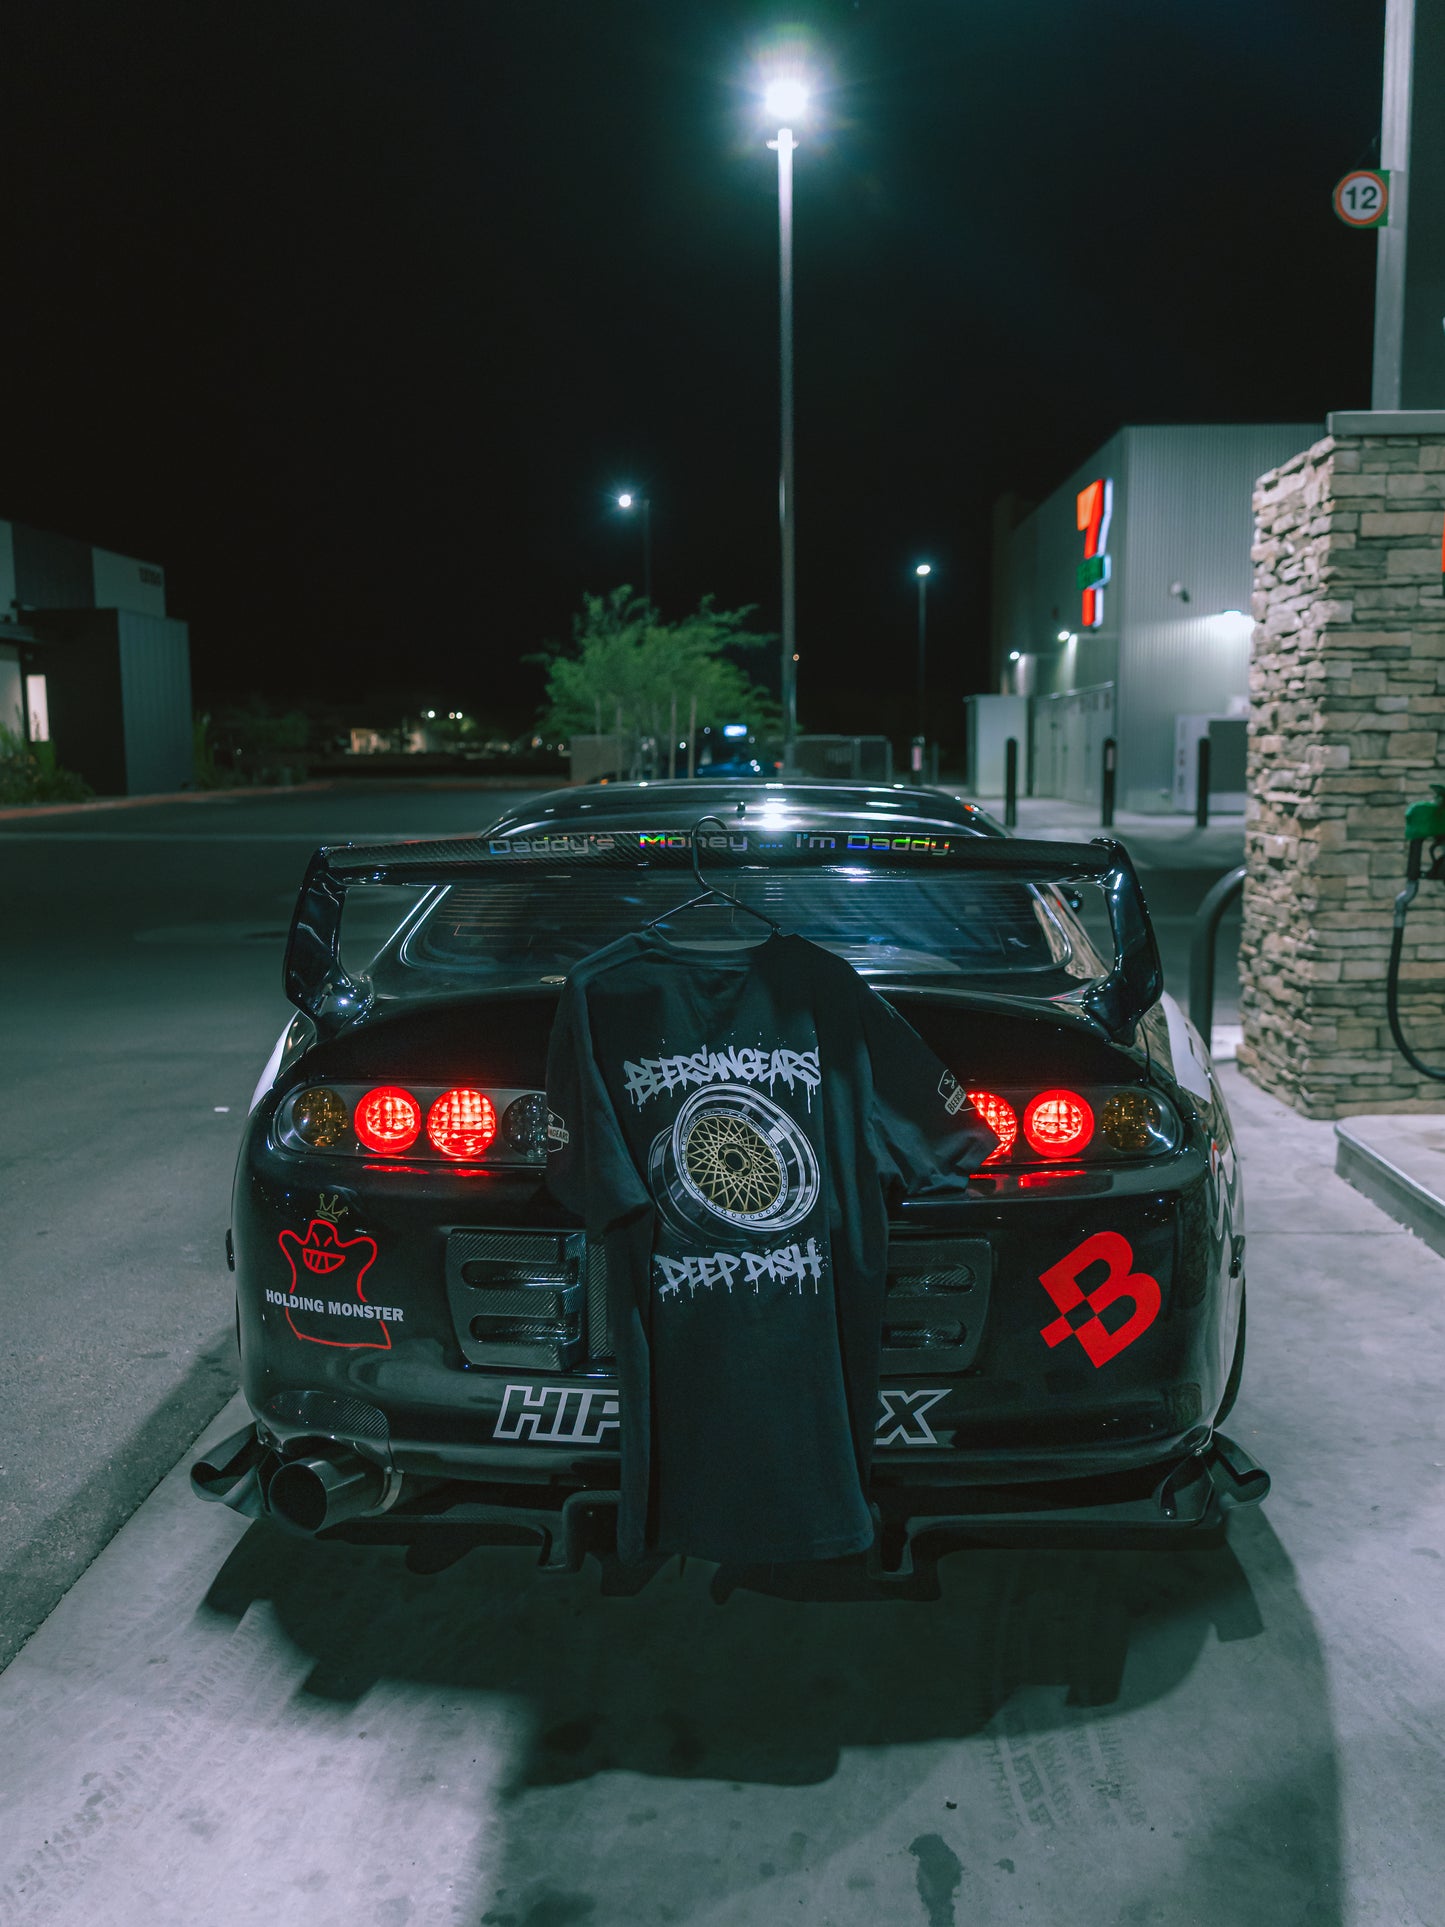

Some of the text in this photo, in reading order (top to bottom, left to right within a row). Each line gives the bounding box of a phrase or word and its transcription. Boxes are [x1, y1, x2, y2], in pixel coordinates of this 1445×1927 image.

[1345, 186, 1377, 210] 12
[488, 834, 616, 854] Daddy's
[639, 833, 748, 851] Money
[796, 833, 836, 849] I'm
[654, 1251, 742, 1298] DEEP
[265, 1288, 404, 1322] HOLDING MONSTER
